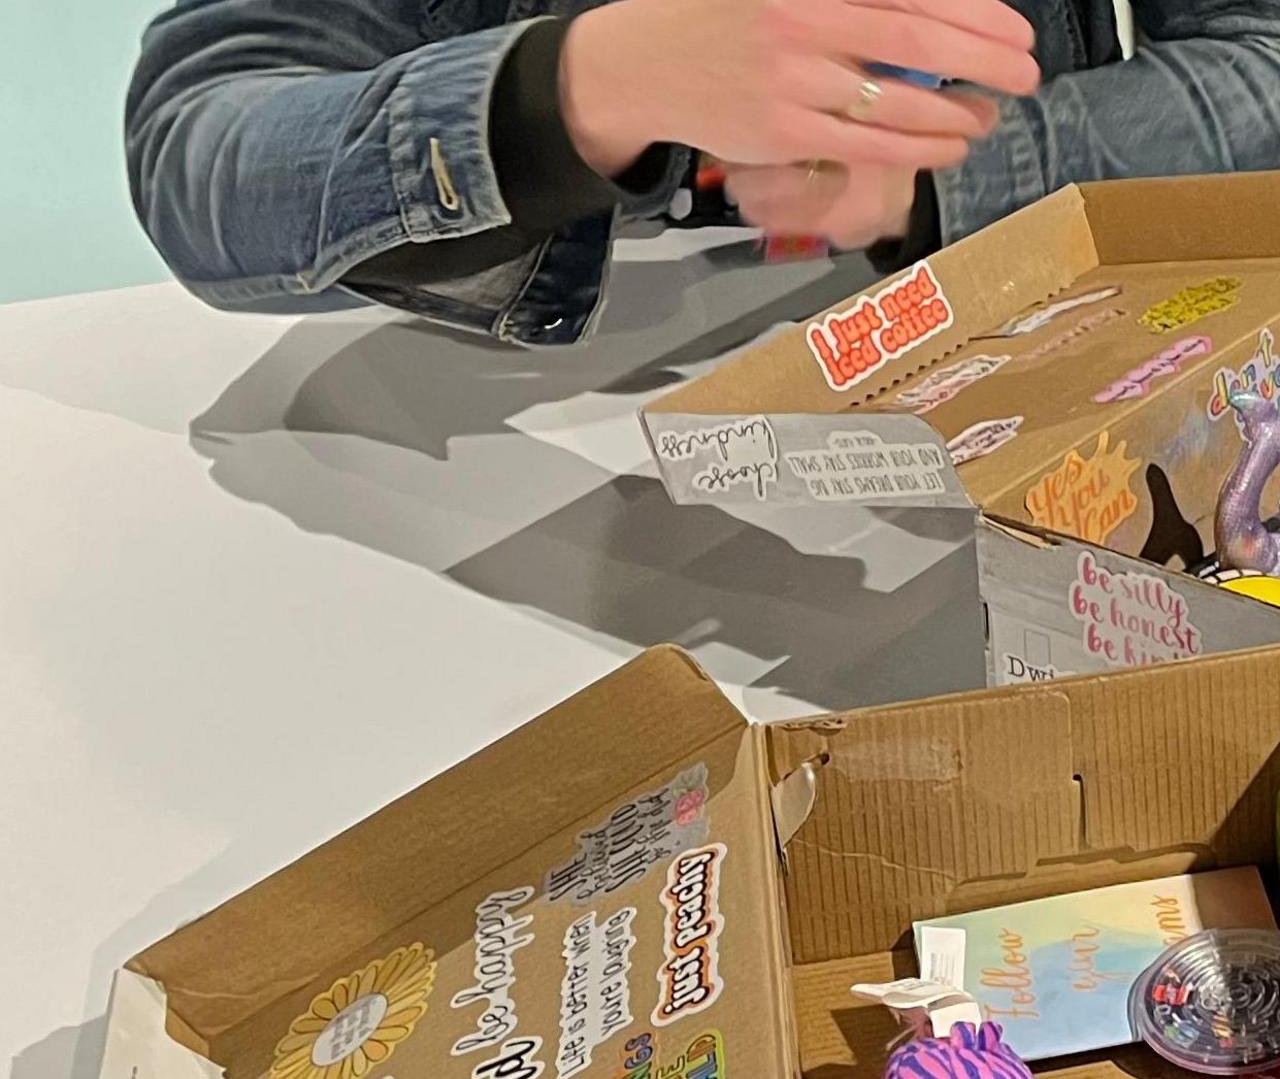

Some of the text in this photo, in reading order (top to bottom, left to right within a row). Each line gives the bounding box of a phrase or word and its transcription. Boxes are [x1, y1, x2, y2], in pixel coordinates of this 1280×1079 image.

[811, 329, 833, 359] I
[879, 266, 937, 322] need
[880, 298, 949, 353] coffee
[661, 420, 775, 462] kindness
[788, 448, 940, 473] AND YOUR WORRIES STAY SMALL
[698, 462, 774, 497] choose
[810, 473, 943, 496] LET YOUR DREAMS STAY BIG
[1073, 585, 1199, 655] be honest
[1083, 556, 1185, 629] be silly
[1006, 654, 1054, 681] Dwi
[1087, 623, 1118, 660] be
[550, 852, 588, 901] SHE
[605, 804, 646, 893] SHE COULD
[598, 910, 631, 985] laughing
[663, 852, 716, 1014] just peachy
[1150, 895, 1188, 947] ams
[454, 891, 528, 1051] be happy
[979, 927, 1039, 1020] Follow
[1067, 925, 1132, 990] your
[560, 913, 593, 1077] Life is better when
[624, 1032, 653, 1079] NGS
